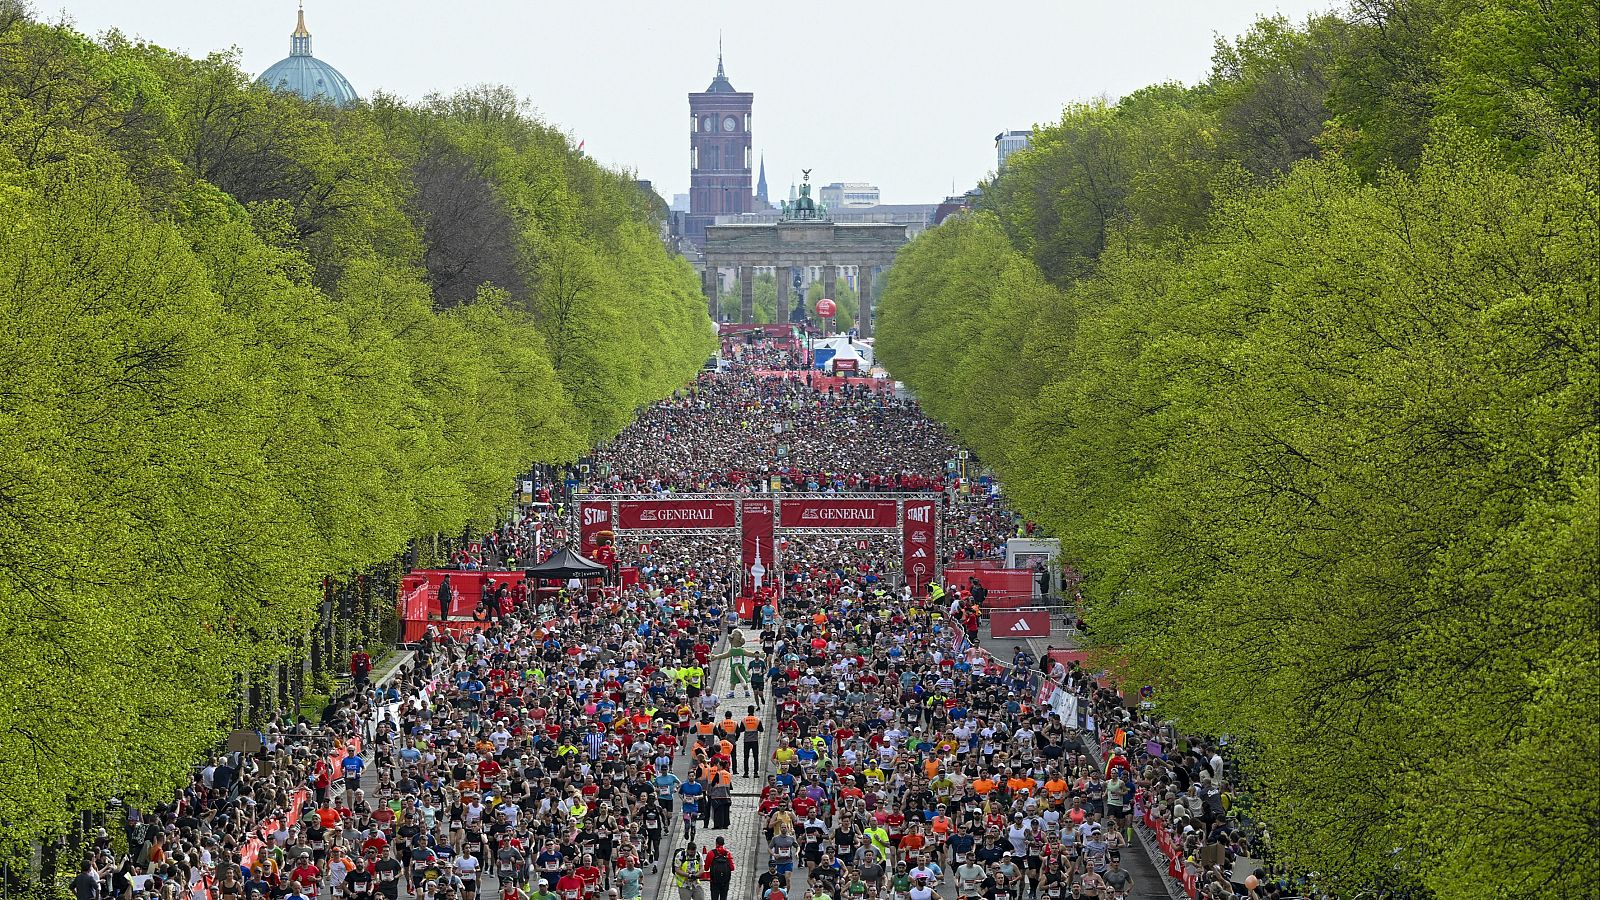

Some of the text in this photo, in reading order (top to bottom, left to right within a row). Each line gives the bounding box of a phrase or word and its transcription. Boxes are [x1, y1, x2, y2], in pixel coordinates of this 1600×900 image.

[658, 508, 714, 520] GENERALI
[820, 508, 876, 520] GENERALI
[908, 506, 931, 523] START
[556, 530, 564, 538] A
[471, 544, 478, 552] A
[641, 545, 648, 553] A
[859, 541, 866, 549] A
